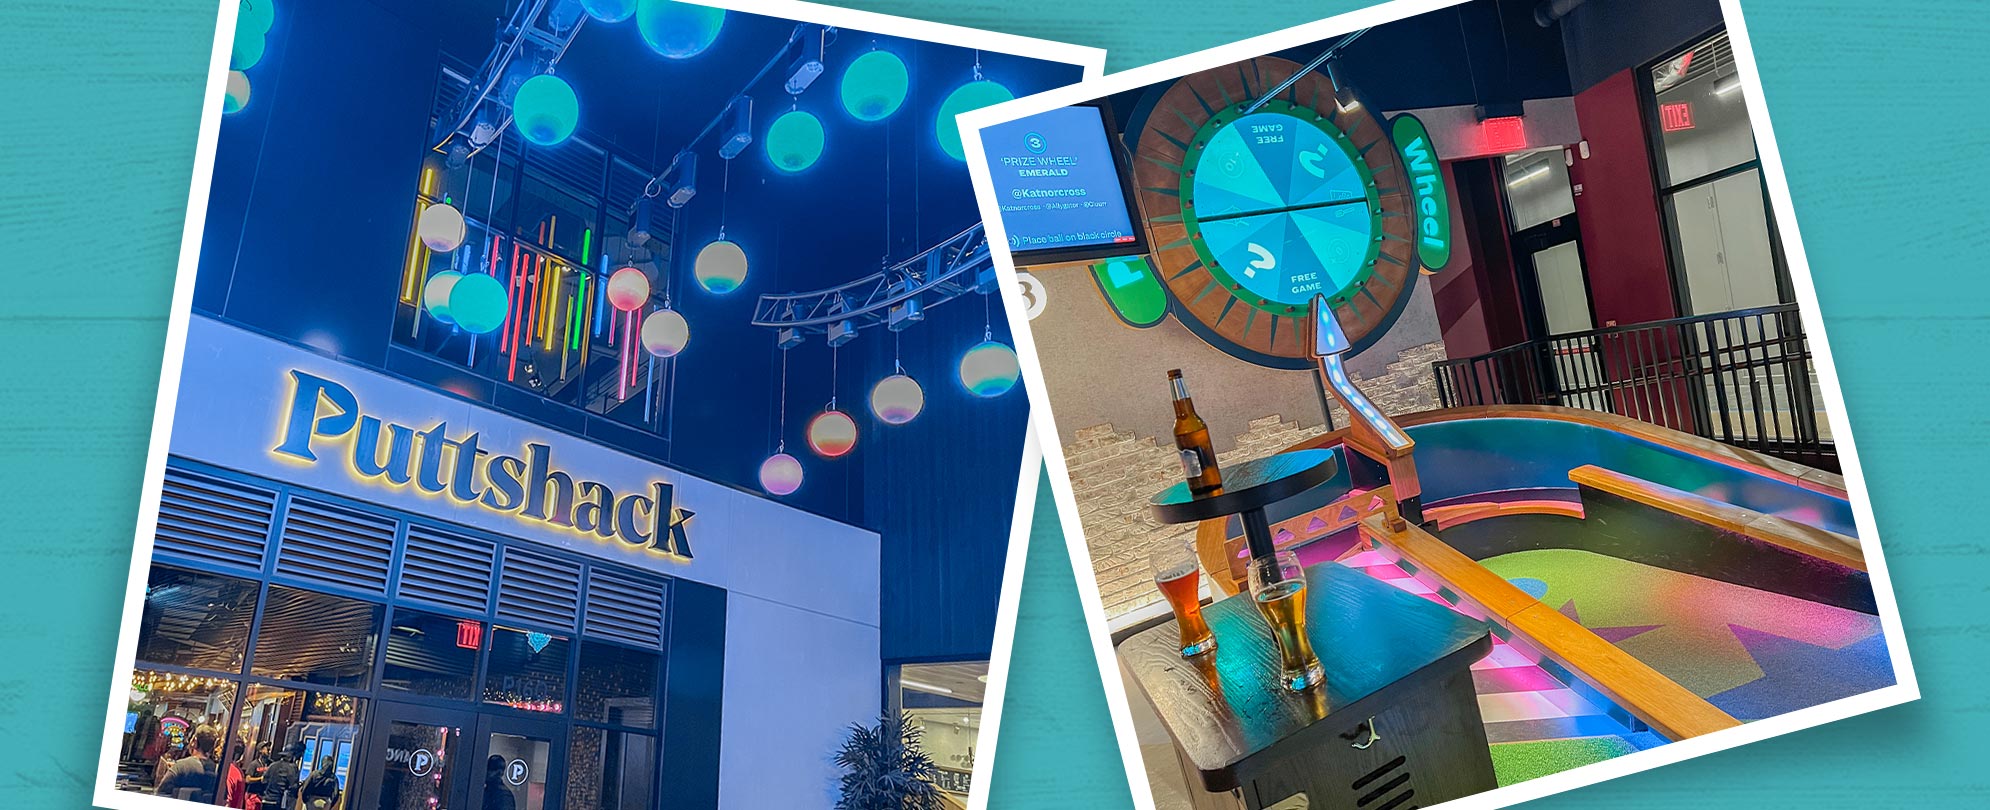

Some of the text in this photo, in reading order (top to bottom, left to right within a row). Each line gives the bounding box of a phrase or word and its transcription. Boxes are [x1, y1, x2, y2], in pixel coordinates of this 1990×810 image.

[1251, 123, 1284, 133] GAME
[1029, 137, 1041, 149] 3
[1256, 135, 1284, 144] FREE
[1019, 168, 1069, 178] EMERALD
[1011, 187, 1087, 200] @Katnorcross
[1403, 135, 1446, 249] Wheel
[1022, 235, 1048, 245] Place
[1047, 234, 1064, 244] ball
[1065, 234, 1077, 242] on
[1077, 231, 1100, 241] black
[1100, 230, 1122, 240] circle
[1290, 271, 1318, 284] FREE
[1291, 281, 1322, 295] GAME
[272, 369, 697, 560] Puttshack
[413, 753, 429, 771] P
[511, 764, 524, 780] P
